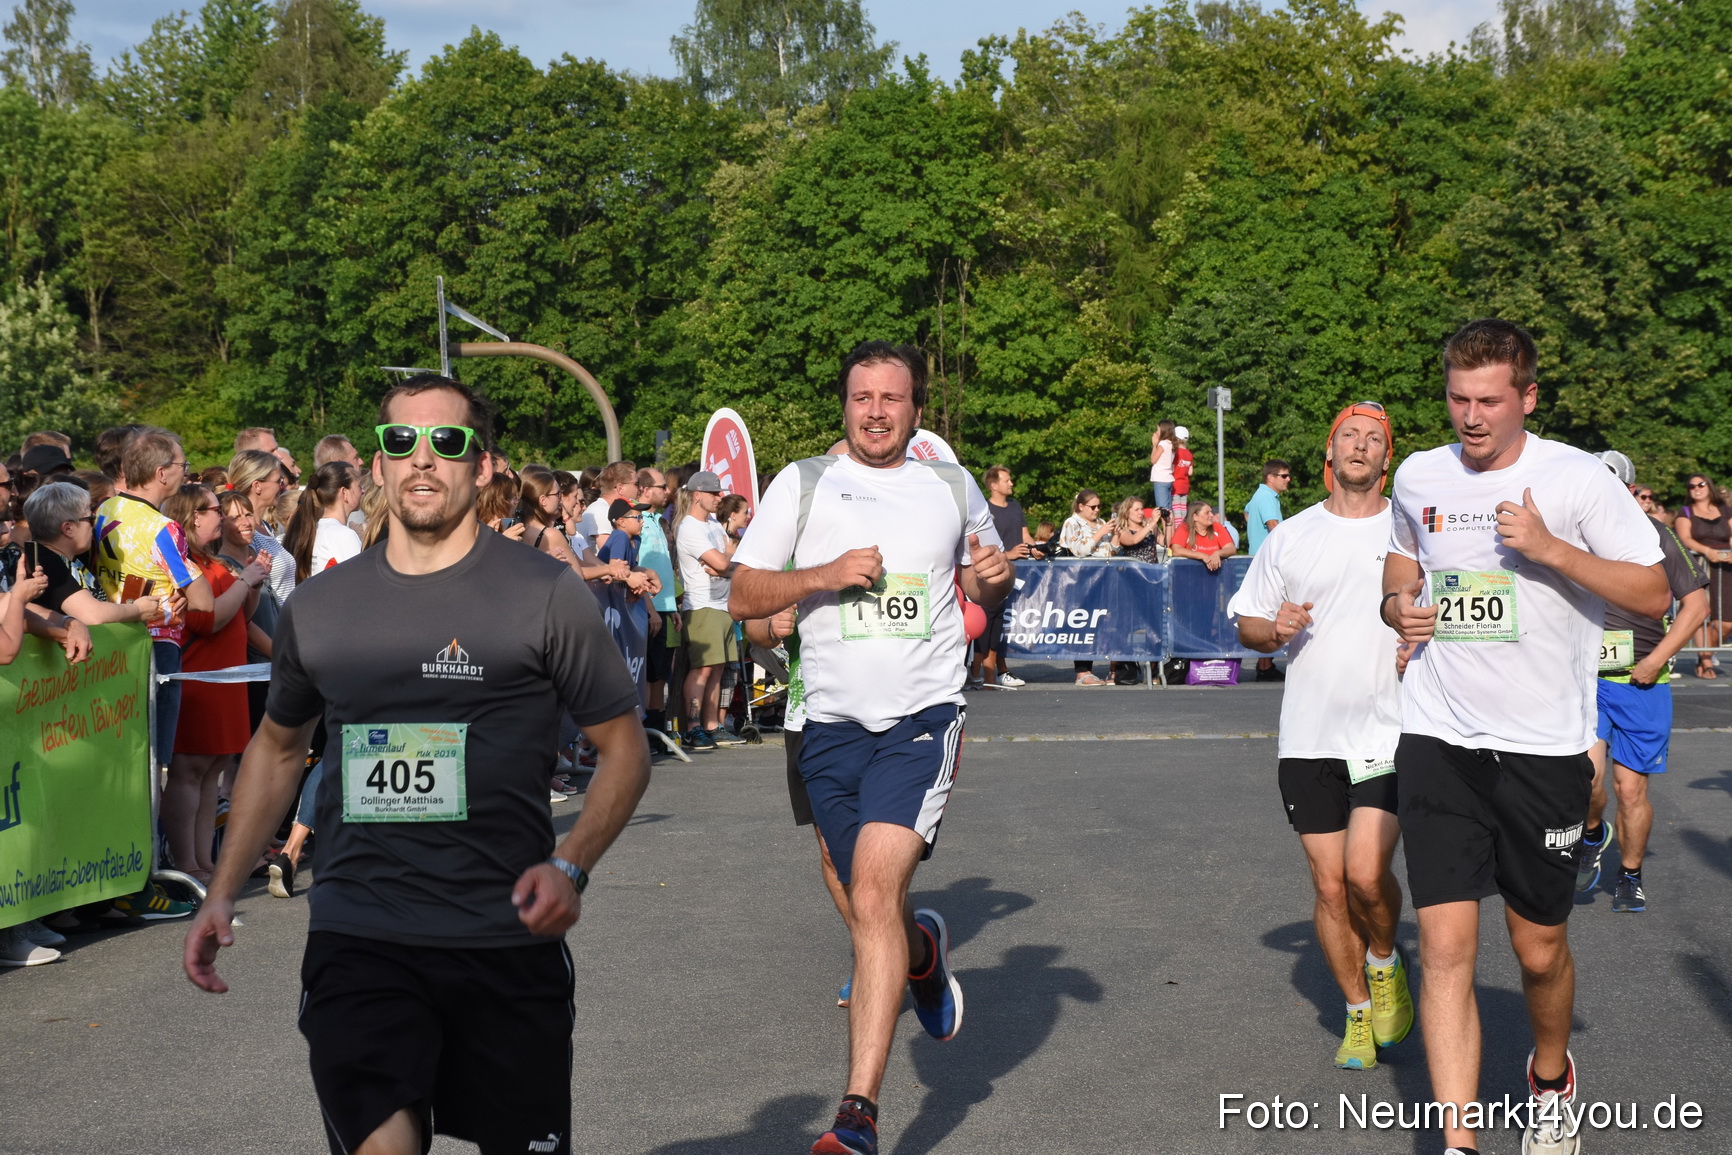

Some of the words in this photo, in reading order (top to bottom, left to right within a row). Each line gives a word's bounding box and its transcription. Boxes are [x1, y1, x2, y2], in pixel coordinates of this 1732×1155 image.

[852, 596, 918, 620] 1469
[1439, 596, 1504, 621] 2150
[1444, 622, 1475, 630] Schneider
[421, 662, 484, 676] BURKHARDT
[16, 654, 80, 715] Gesunde
[83, 650, 129, 689] Firmen
[40, 703, 90, 754] laufen
[90, 678, 140, 739] länger!
[361, 742, 407, 753] firmenlauf
[434, 749, 457, 758] 2019
[366, 759, 435, 794] 405
[360, 796, 401, 806] Dollinger
[403, 795, 444, 805] Matthias
[1545, 825, 1583, 848] PUMA
[528, 1140, 557, 1152] PUMA
